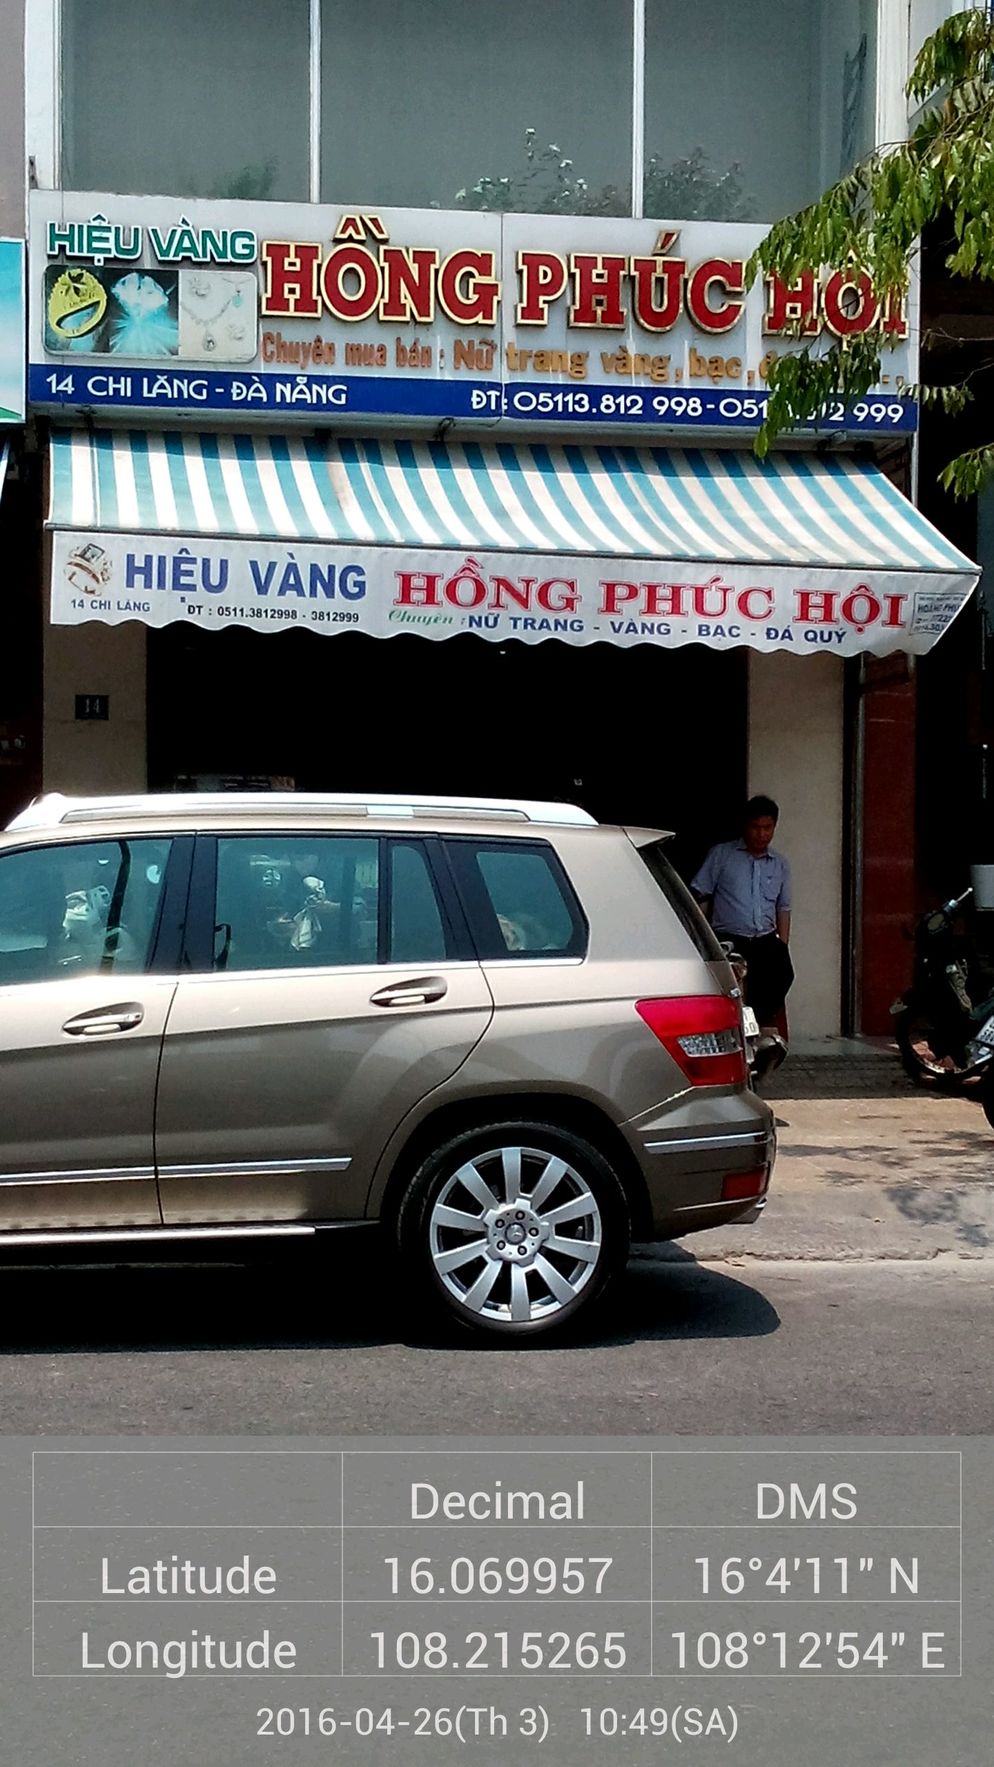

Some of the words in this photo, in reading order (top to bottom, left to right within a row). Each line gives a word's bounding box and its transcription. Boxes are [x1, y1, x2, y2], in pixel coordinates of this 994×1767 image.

[48, 213, 142, 266] HIỆU
[150, 215, 257, 264] VÀNG
[261, 215, 499, 326] HỒNG
[516, 230, 746, 334] PHÚC
[261, 331, 336, 370] Chuyên
[344, 341, 387, 367] mua
[395, 336, 433, 369] bán
[453, 338, 499, 371] Nữ
[505, 341, 589, 379] trang
[46, 373, 75, 395] 14
[86, 375, 131, 398] CHI
[142, 374, 208, 400] LĂNG
[231, 375, 268, 402] ĐÀ
[852, 402, 904, 424] 999
[125, 547, 229, 603] HIỆU
[250, 552, 367, 601] VÀNG
[71, 599, 85, 609] 14
[90, 600, 111, 610] CHI
[394, 556, 582, 615] HỒNG
[597, 576, 776, 622] PHÚC
[793, 582, 908, 634] HỘI
[216, 606, 298, 620] 0511.3812998
[311, 611, 360, 623] 3812999
[468, 613, 500, 629] NỮ
[510, 616, 584, 632] TRANG
[610, 617, 672, 635] VÀNG
[698, 623, 741, 641] BẠC
[766, 623, 794, 642] ĐÁ
[804, 626, 847, 644] QUÝ
[86, 698, 99, 713] 14
